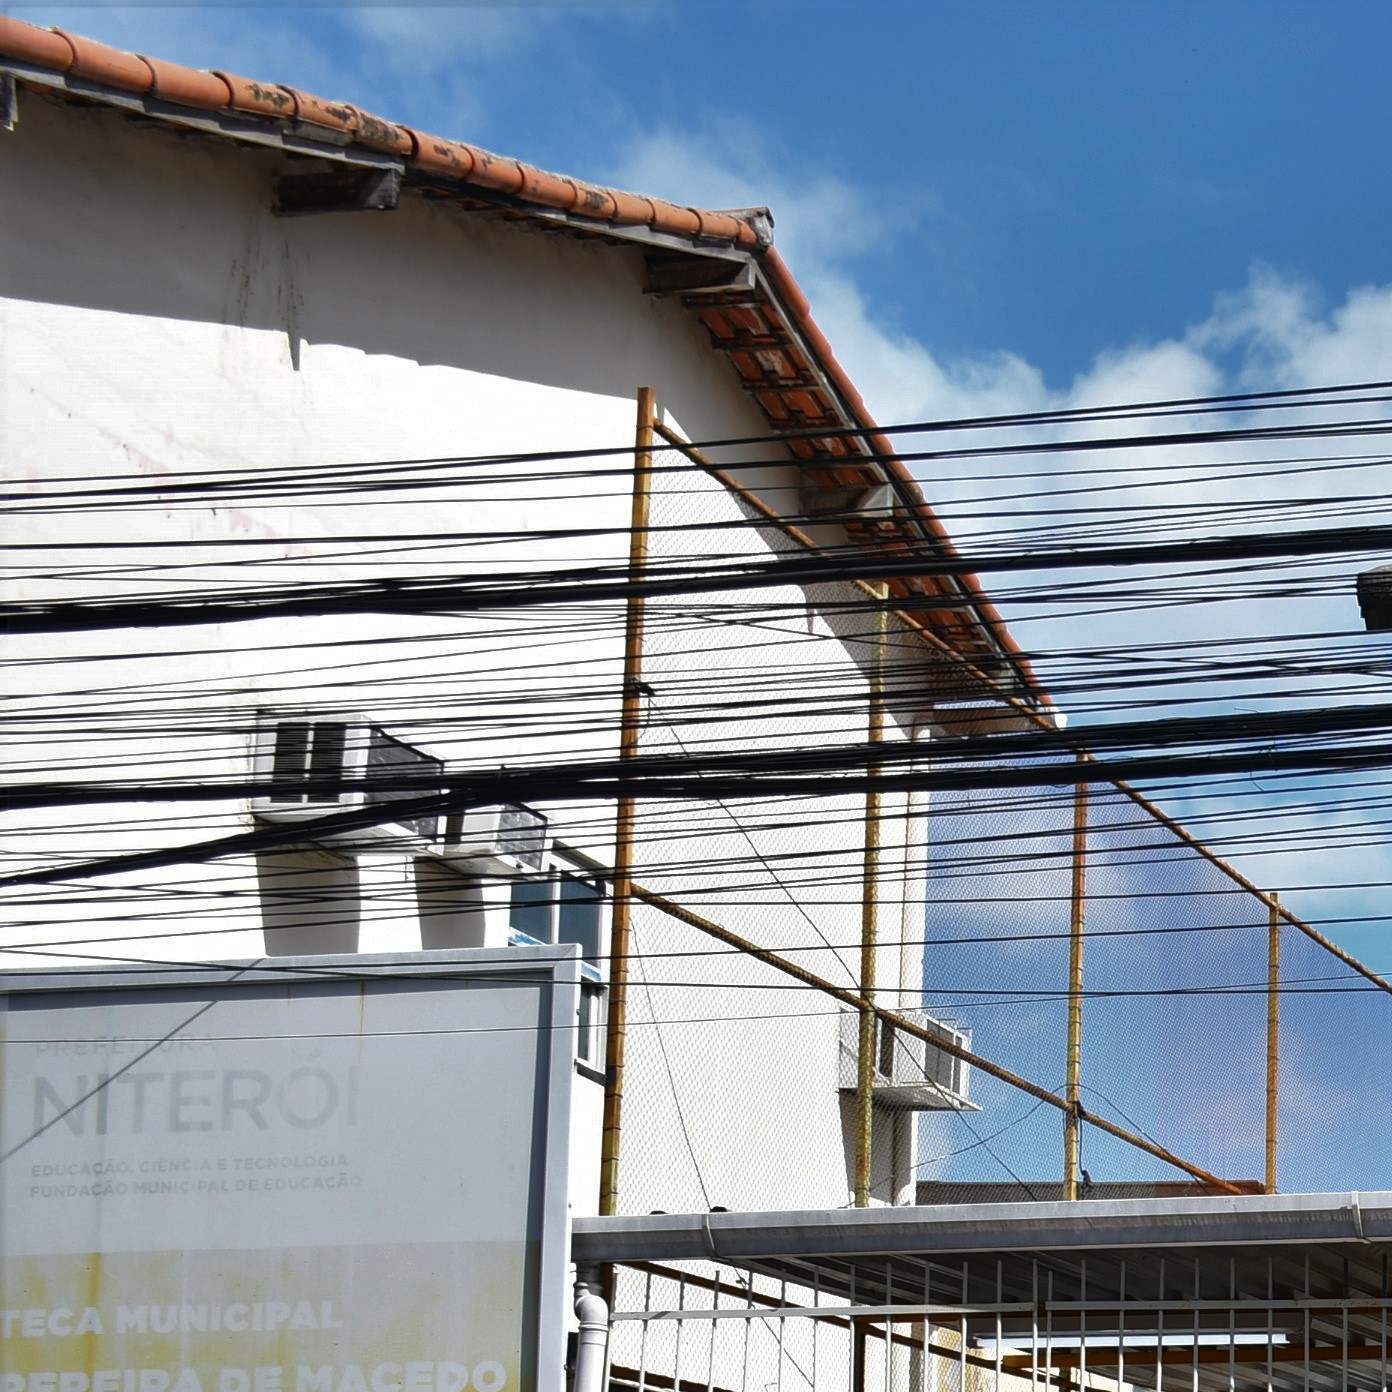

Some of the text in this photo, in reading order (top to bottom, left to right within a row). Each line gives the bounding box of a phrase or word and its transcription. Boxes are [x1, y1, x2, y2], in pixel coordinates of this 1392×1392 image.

[35, 1032, 219, 1058] PREFEITURA
[33, 1047, 359, 1137] NITERÓI
[31, 1154, 348, 1178] EDUCAÇÃO, CIÊNCIA E TECNOLOGIA
[30, 1172, 363, 1198] FUNDAÇÃO MUNICIPAL DE EDUCAÇÃO
[116, 1301, 344, 1335] MUNICIPAL
